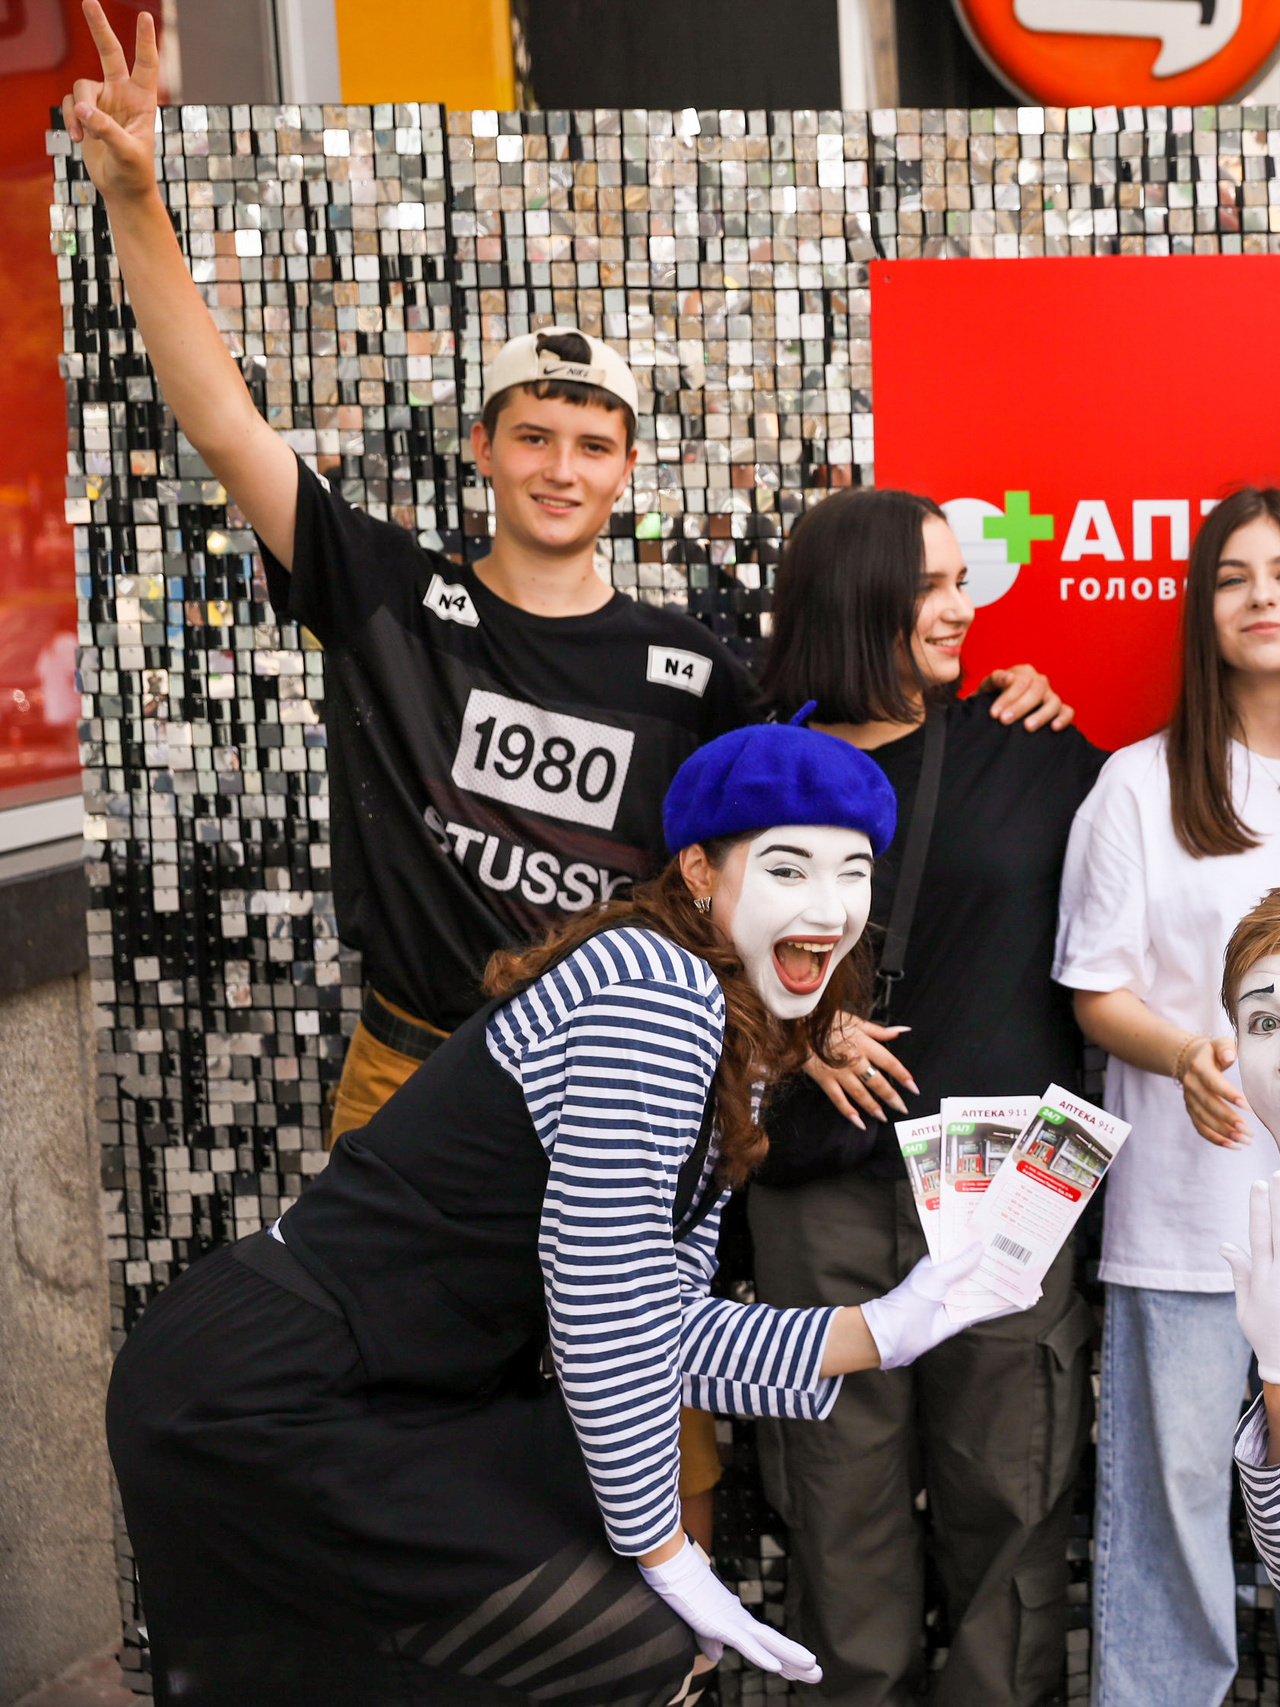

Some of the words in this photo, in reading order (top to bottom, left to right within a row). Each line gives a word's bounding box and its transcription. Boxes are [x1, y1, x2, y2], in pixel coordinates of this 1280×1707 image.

[1060, 577, 1188, 601] ГОЛОВ
[438, 594, 467, 611] N4
[665, 658, 694, 680] N4
[474, 716, 617, 803] 1980
[961, 1109, 1006, 1118] АПТЕКА
[1042, 1108, 1062, 1122] 24/7
[1059, 1100, 1096, 1125] АПТЕКА
[950, 1124, 970, 1133] 24/7
